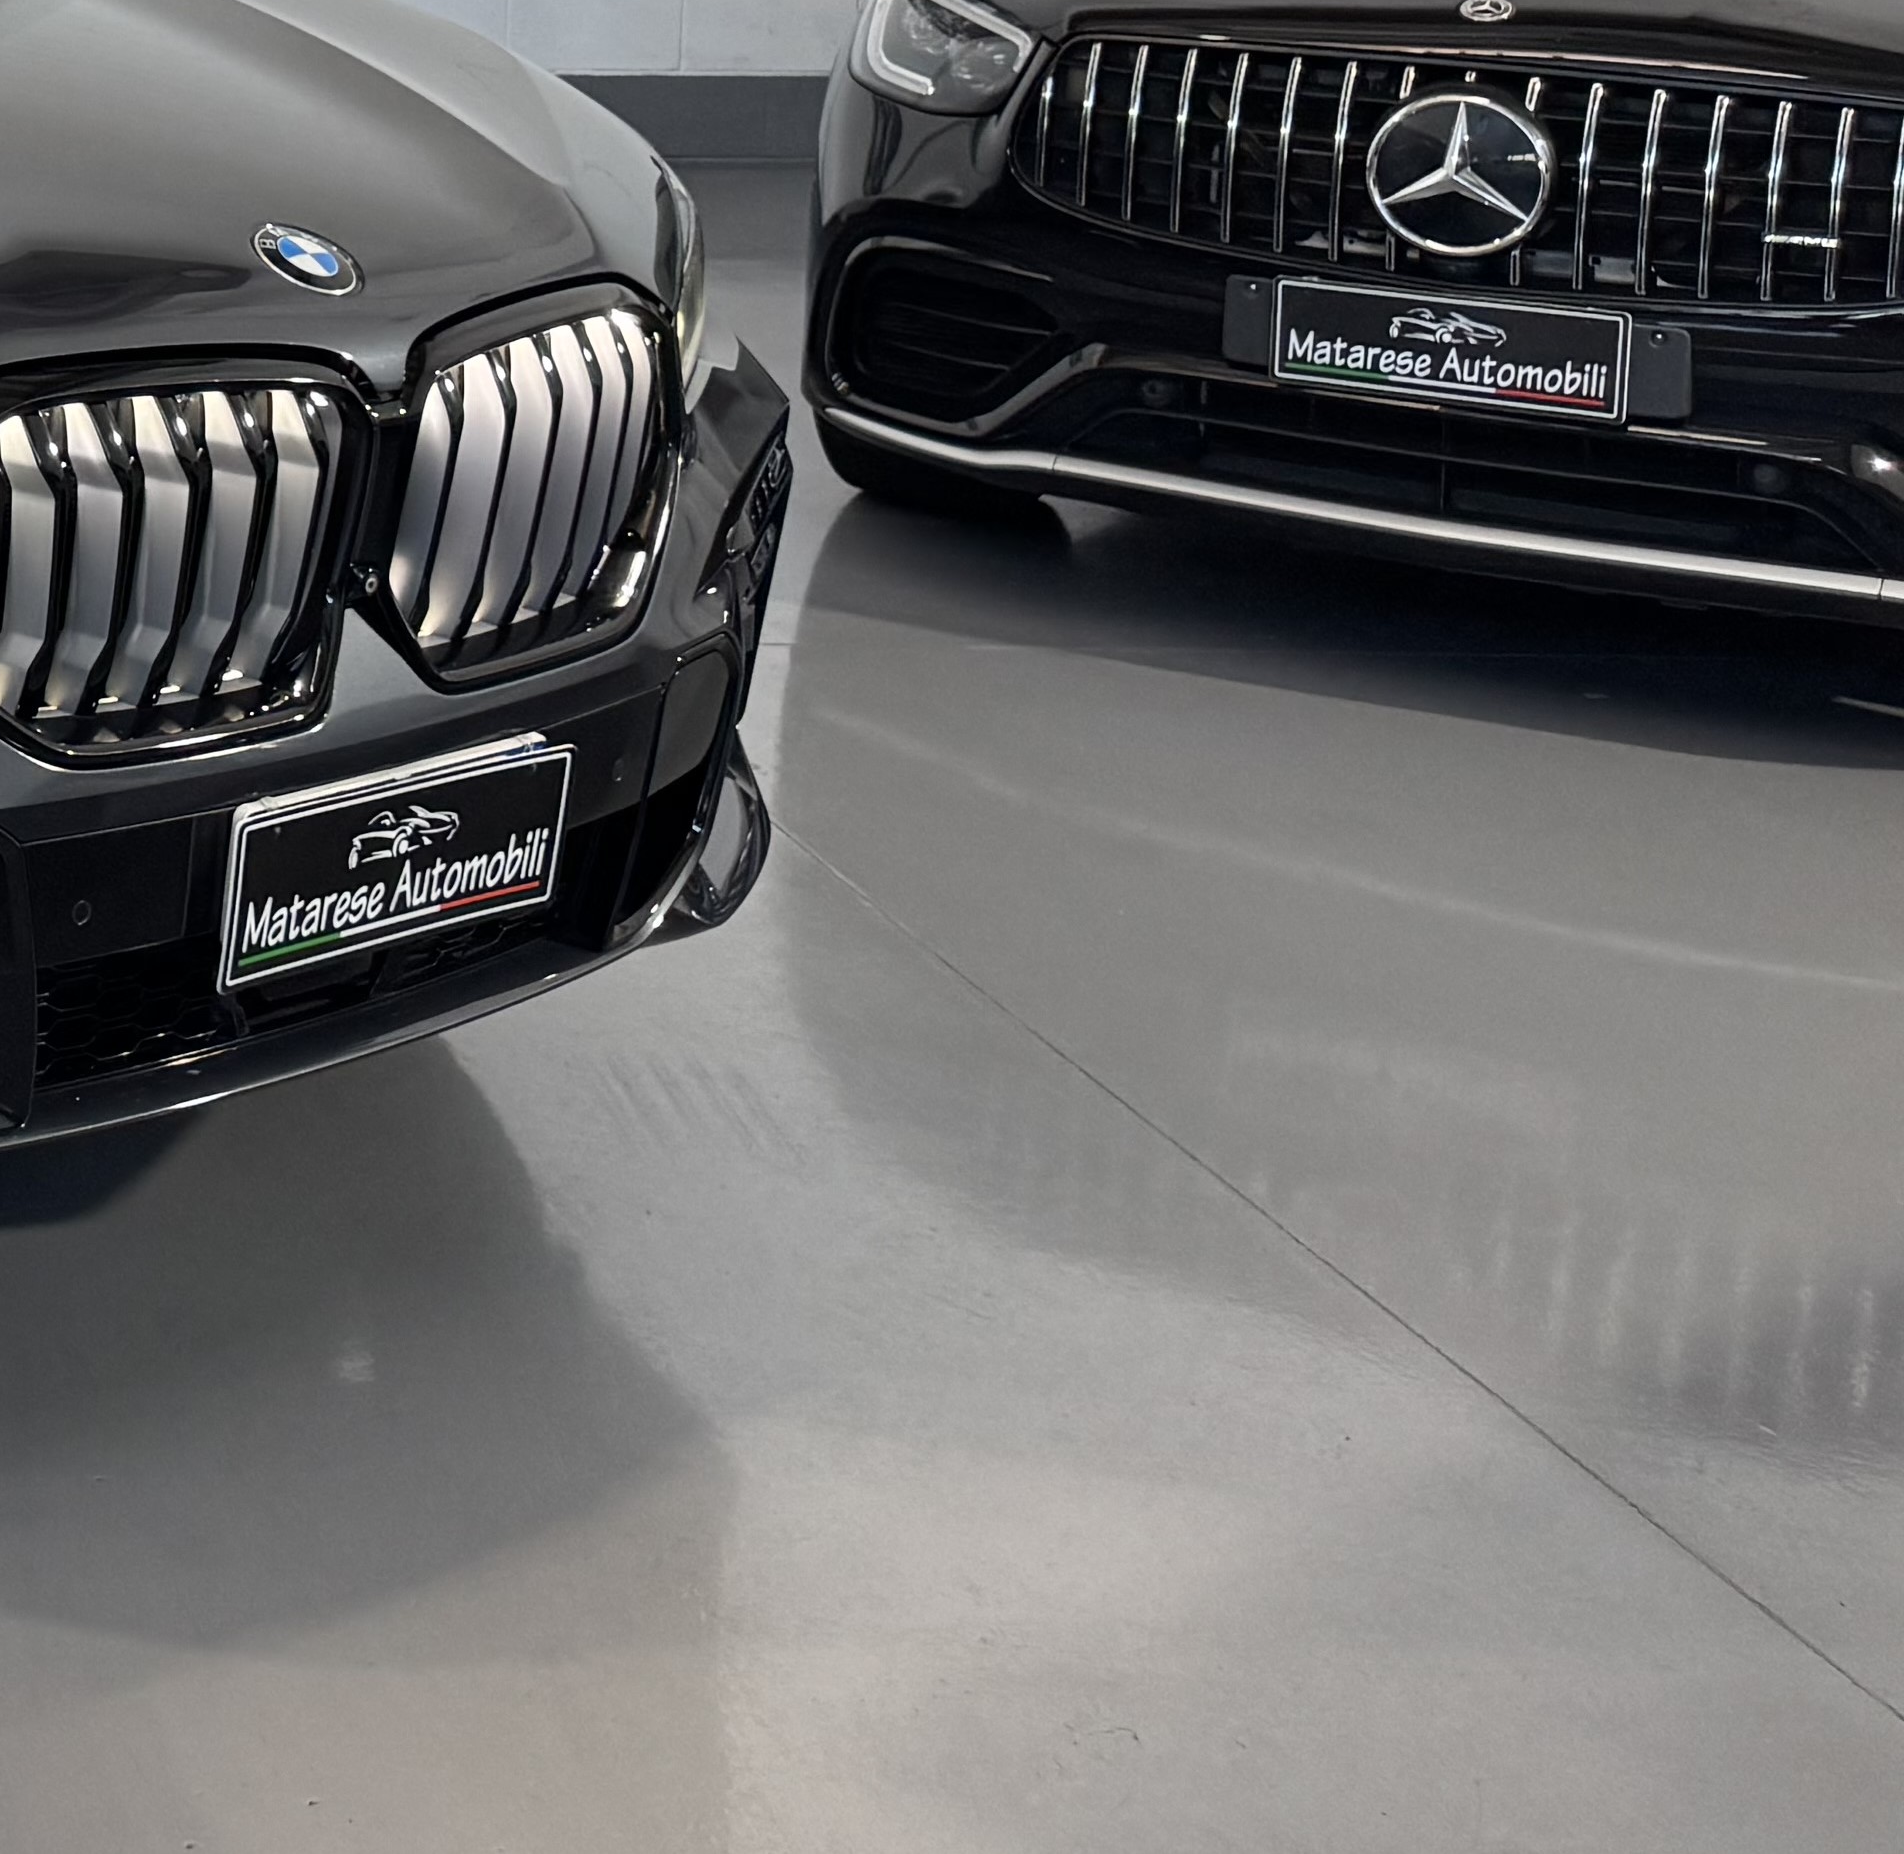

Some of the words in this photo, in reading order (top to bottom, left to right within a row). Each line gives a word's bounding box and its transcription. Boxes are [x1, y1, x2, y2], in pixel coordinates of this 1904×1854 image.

[1287, 328, 1432, 378] Matarese
[1438, 346, 1608, 399] Automobili
[241, 881, 386, 954] Matarese
[389, 827, 550, 914] Automobili
